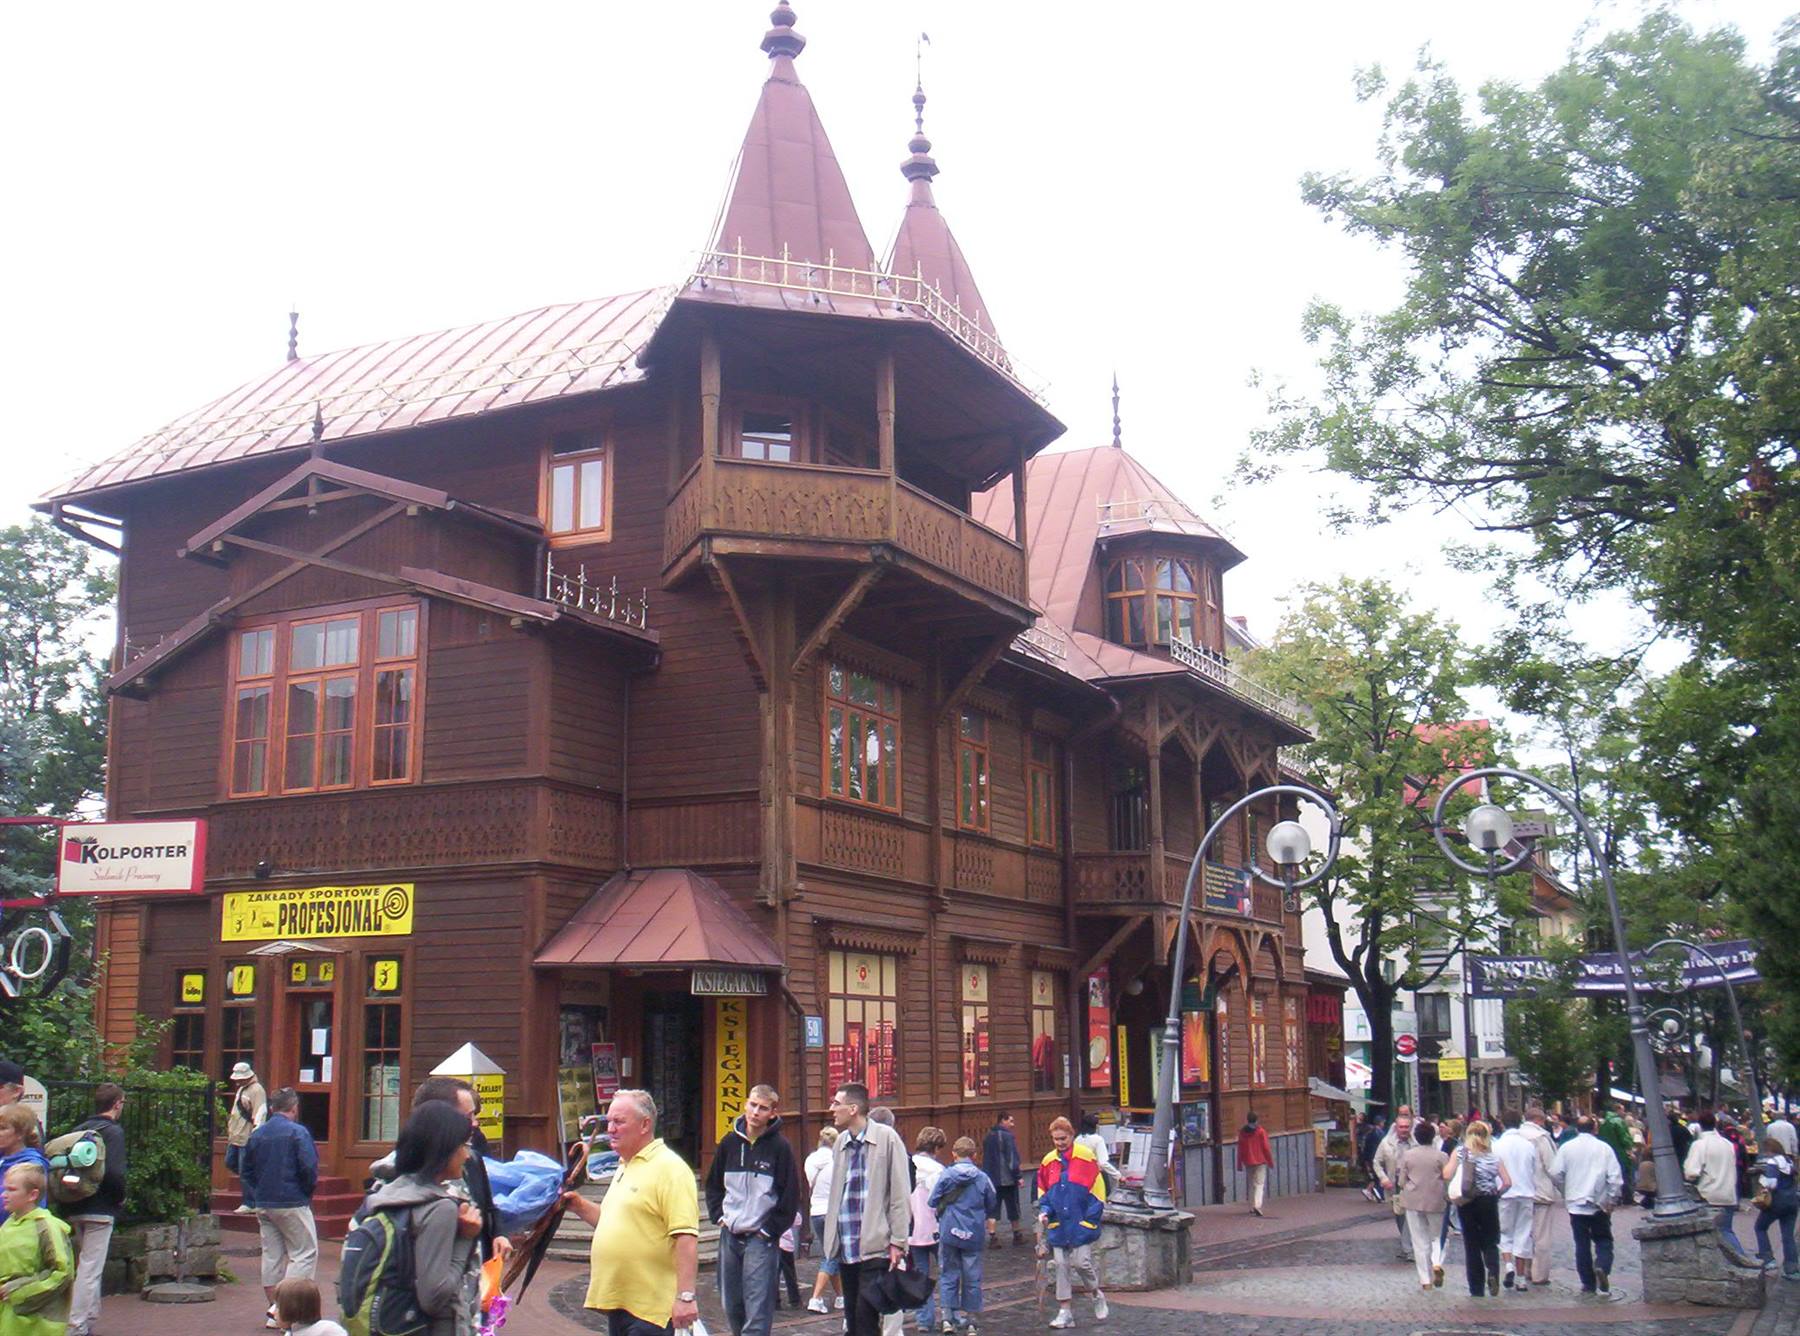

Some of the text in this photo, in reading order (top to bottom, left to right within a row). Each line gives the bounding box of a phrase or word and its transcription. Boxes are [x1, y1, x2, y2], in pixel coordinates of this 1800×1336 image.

[81, 845, 187, 864] KOLPORTER
[309, 888, 380, 899] SPORTOWE
[808, 1019, 819, 1037] 50
